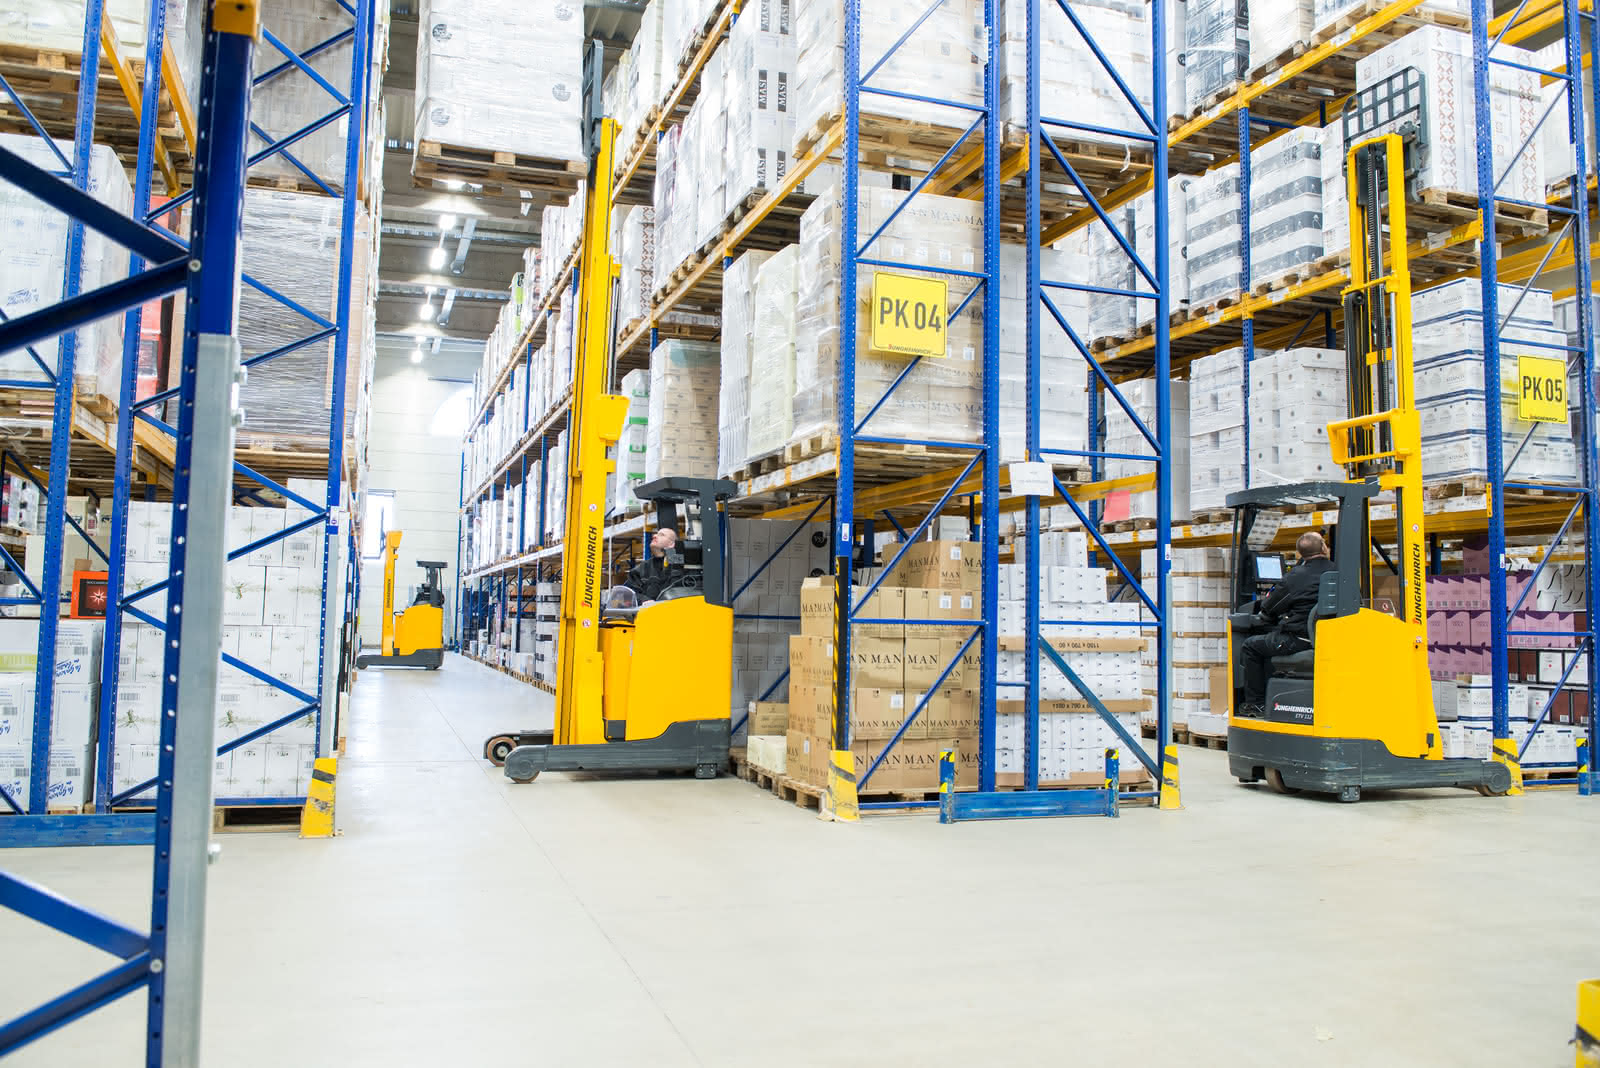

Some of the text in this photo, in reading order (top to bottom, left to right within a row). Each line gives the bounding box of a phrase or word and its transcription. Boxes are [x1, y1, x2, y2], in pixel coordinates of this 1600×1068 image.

[759, 79, 767, 105] MASI
[778, 82, 786, 106] MASI
[965, 215, 984, 227] MA
[880, 296, 942, 333] PK 04
[1523, 376, 1563, 403] PK 05
[581, 525, 597, 608] JUNGHEINRICH
[964, 557, 982, 568] MA
[1413, 543, 1422, 625] JUNGHEINRICH
[871, 654, 901, 664] MAN
[908, 655, 937, 664] MAN
[963, 655, 981, 664] MA
[1274, 703, 1314, 713] JUNGHEINRICH
[905, 755, 935, 764] MAN
[961, 754, 979, 763] MA
